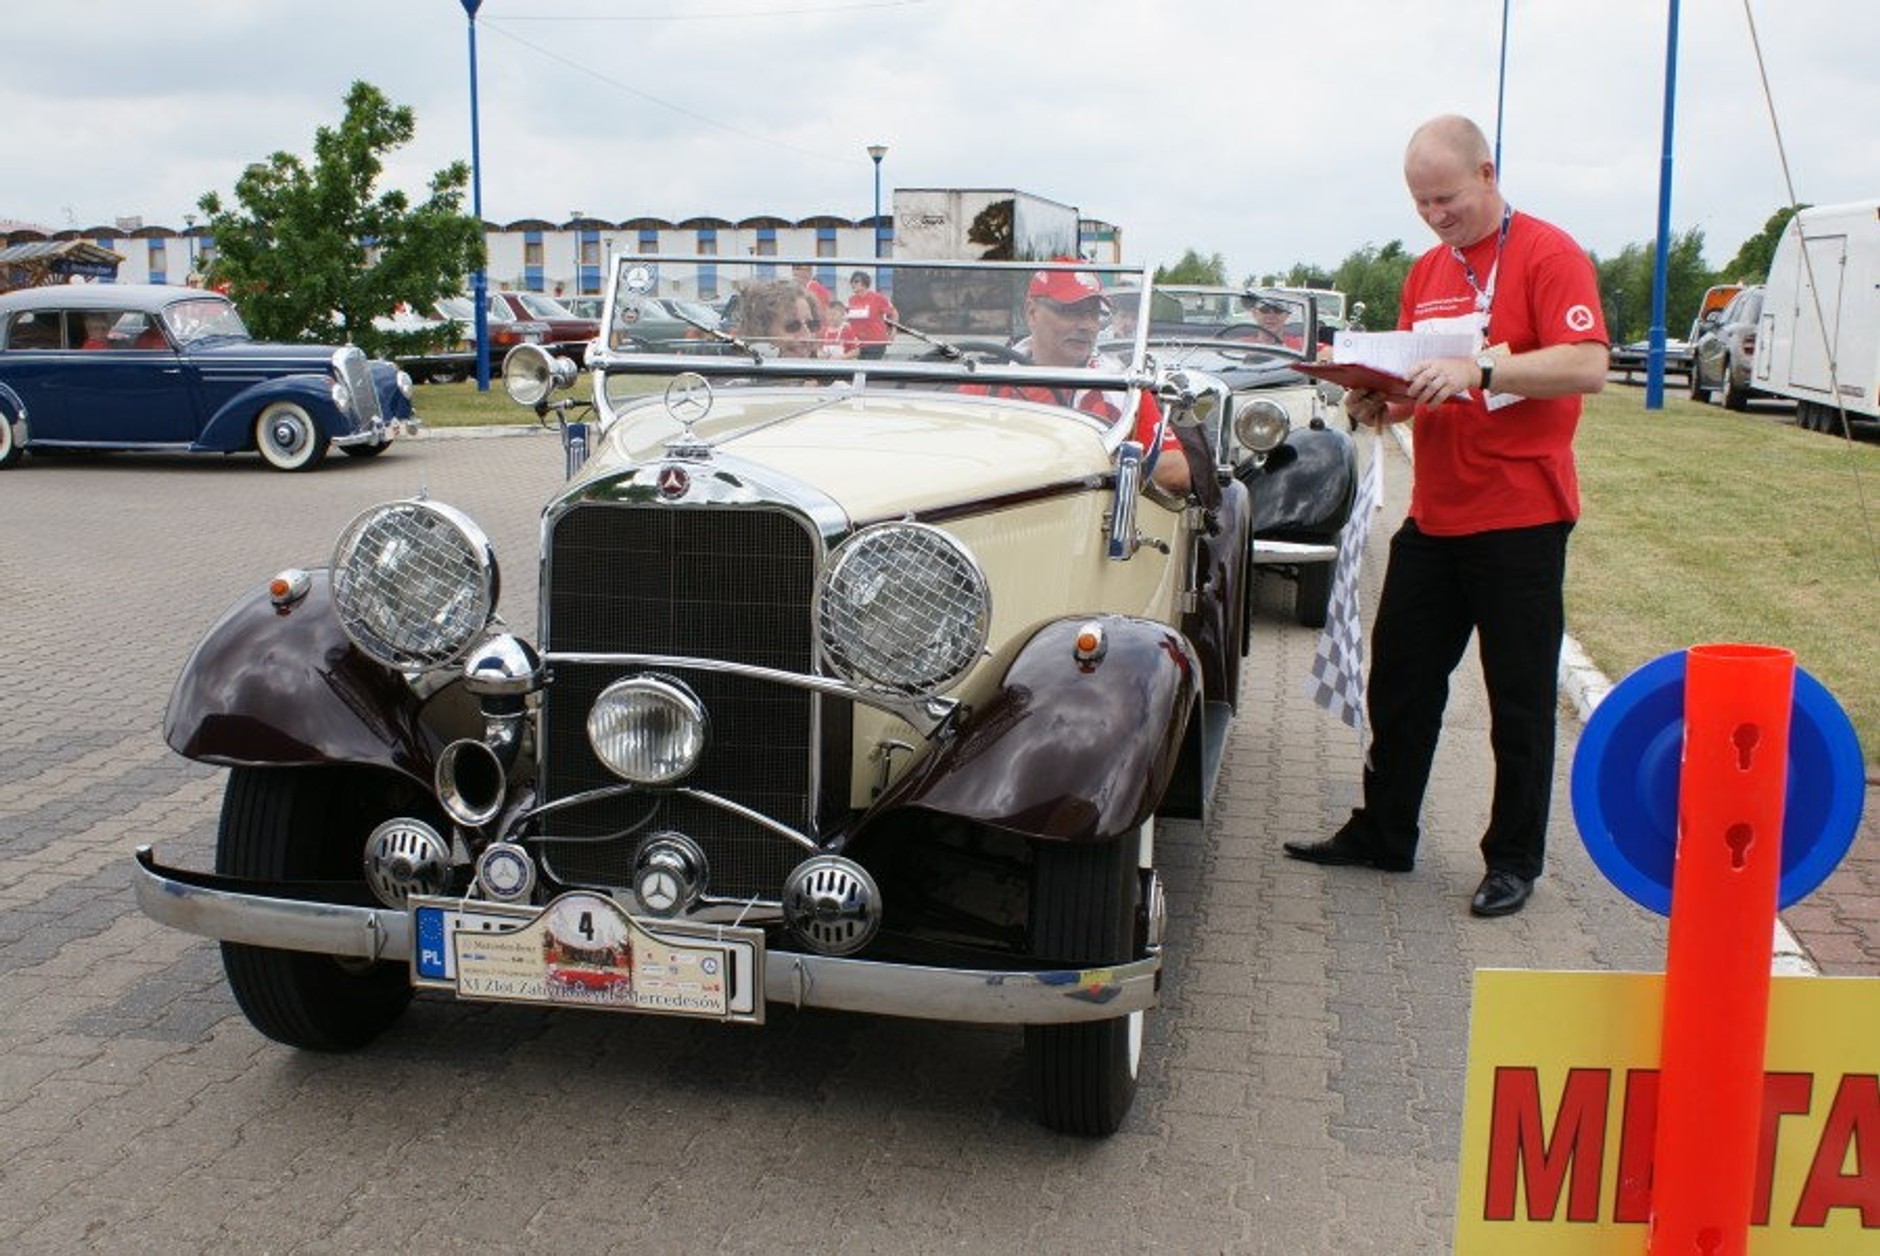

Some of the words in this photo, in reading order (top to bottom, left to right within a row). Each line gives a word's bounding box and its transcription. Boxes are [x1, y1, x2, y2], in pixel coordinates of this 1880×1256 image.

[578, 911, 594, 941] 4
[422, 949, 442, 965] PL
[624, 989, 722, 1008] Mercedesów
